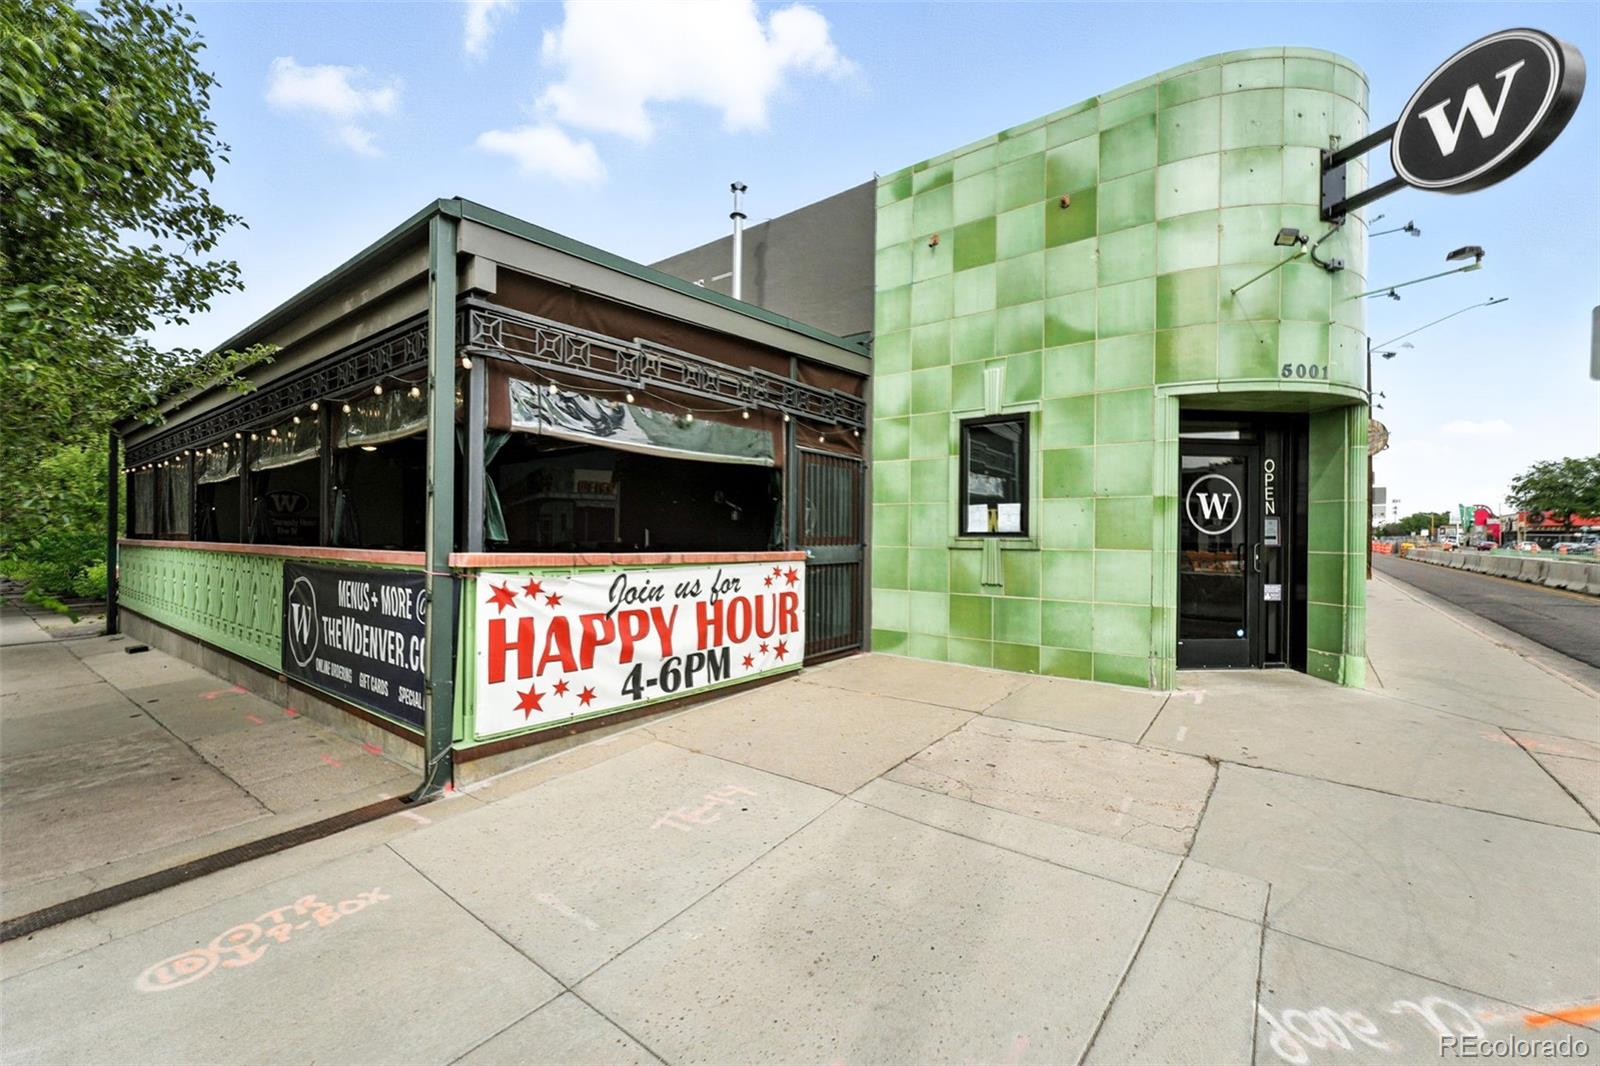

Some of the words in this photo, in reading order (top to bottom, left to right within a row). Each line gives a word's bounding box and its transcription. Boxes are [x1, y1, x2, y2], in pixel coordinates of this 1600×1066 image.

[1418, 59, 1526, 157] W
[1281, 363, 1329, 380] 5001
[1196, 492, 1232, 520] W
[1264, 459, 1276, 515] OPEN
[338, 579, 370, 612] MENUS
[381, 585, 413, 620] MORE
[605, 573, 664, 621] Join
[675, 579, 702, 599] us
[710, 569, 741, 606] for
[291, 603, 312, 645] W
[488, 604, 678, 684] HAPPY
[696, 591, 799, 651] HOUR
[315, 657, 331, 677] ONLINE
[331, 662, 353, 684] ORDERING
[359, 672, 370, 690] GIFT
[371, 675, 389, 697] CARDS
[621, 647, 731, 701] 4-6PM
